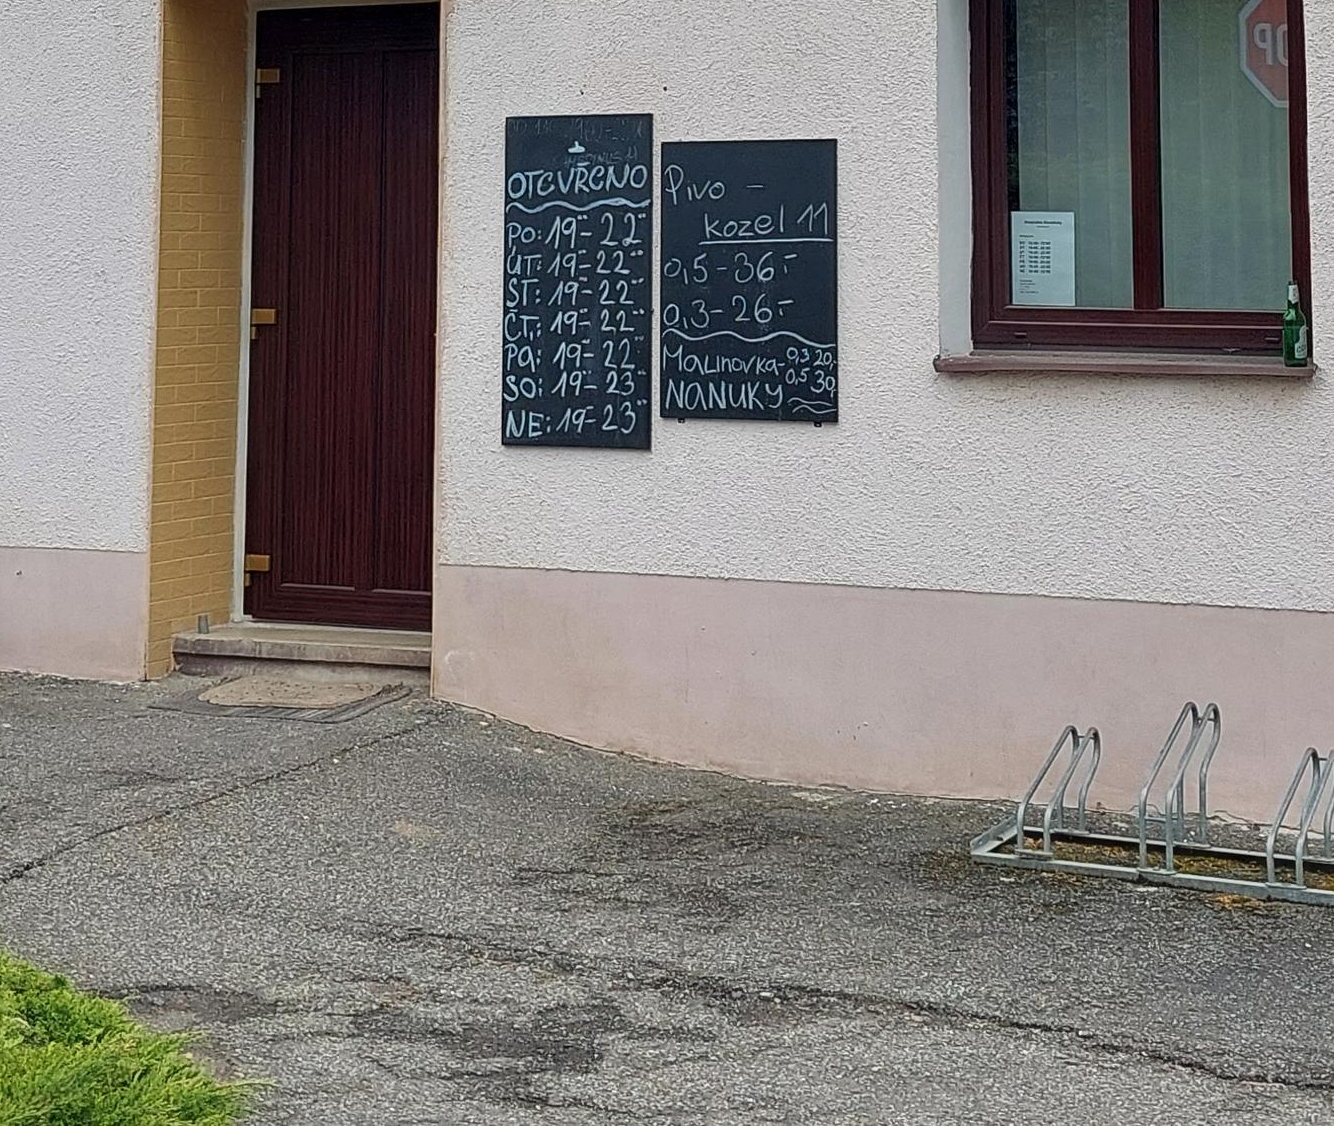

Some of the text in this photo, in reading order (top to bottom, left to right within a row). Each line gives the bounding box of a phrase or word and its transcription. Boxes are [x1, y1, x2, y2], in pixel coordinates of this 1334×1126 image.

[664, 164, 726, 205] Pivo
[796, 202, 828, 236] 11
[785, 368, 810, 385] 0,5
[506, 409, 551, 438] NE:
